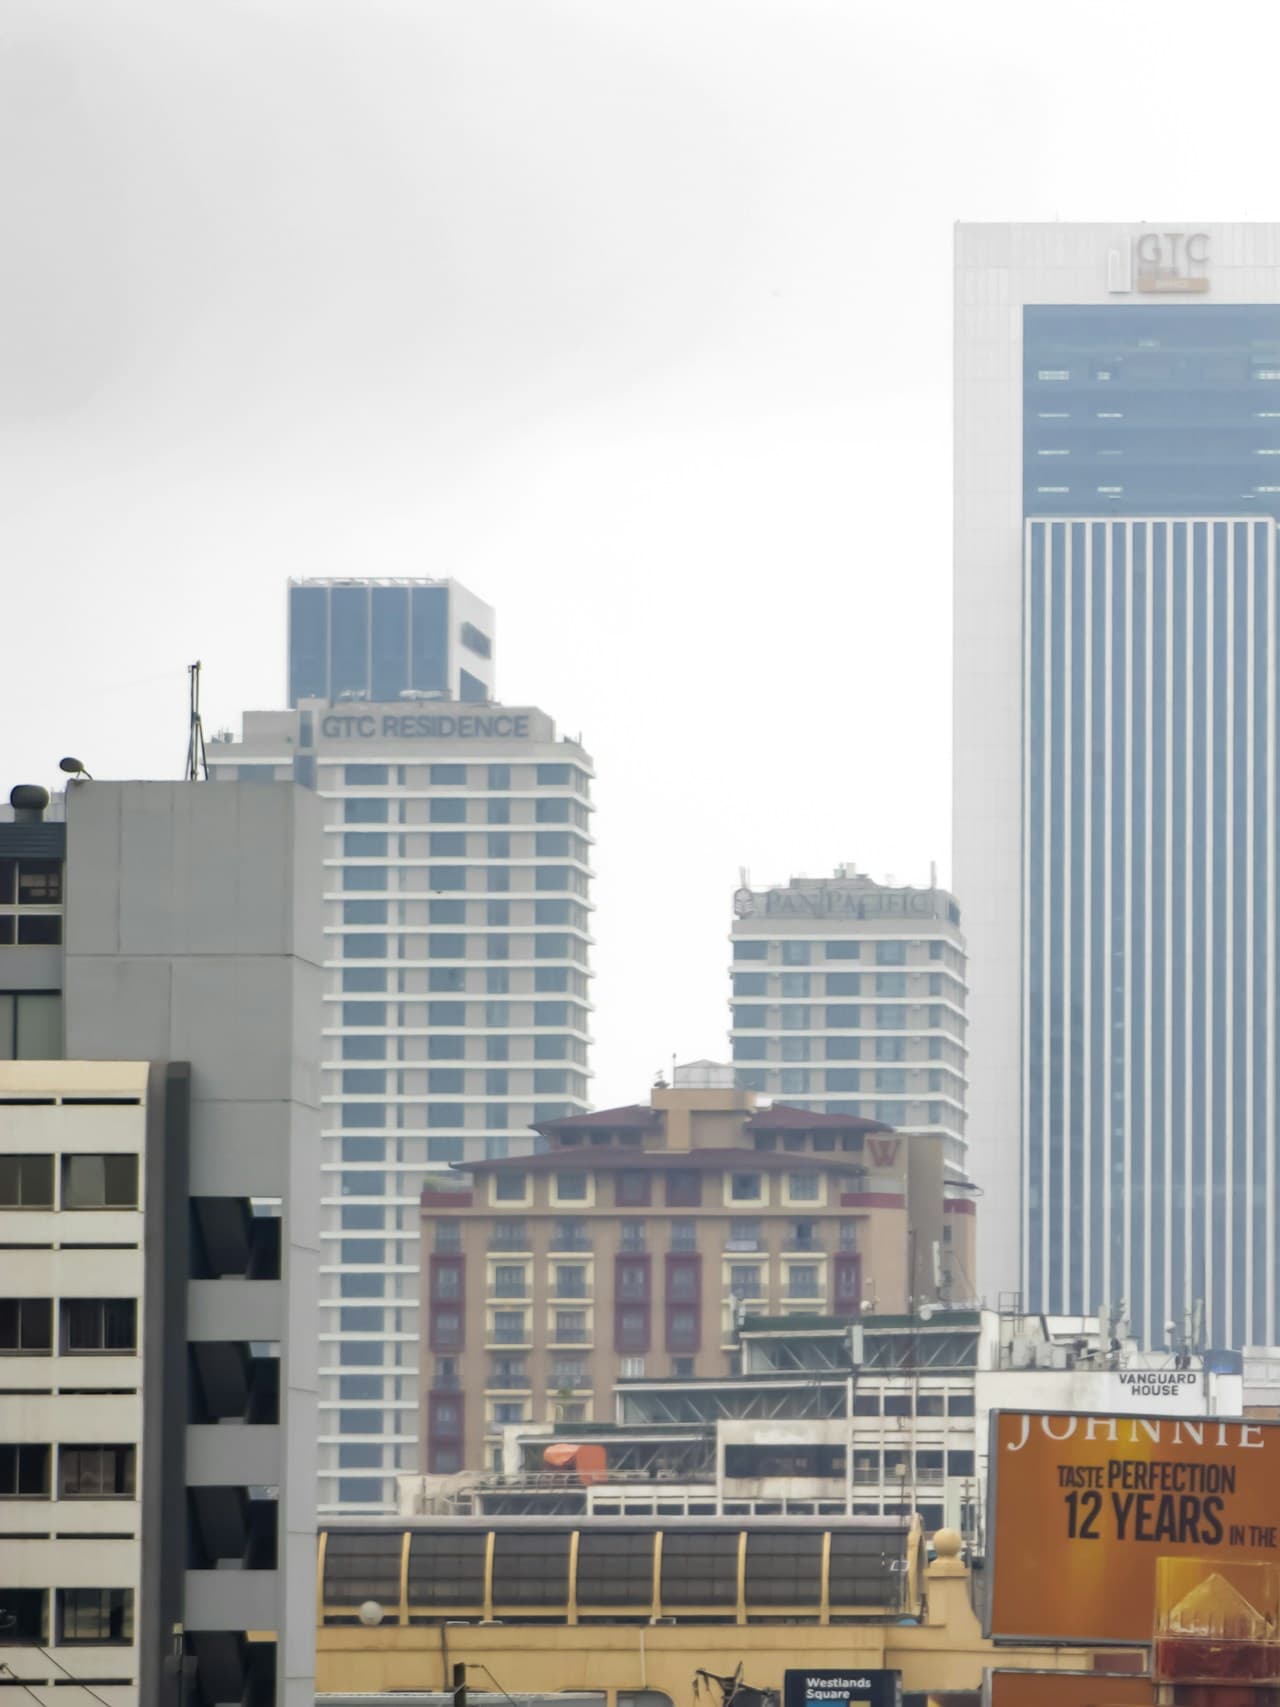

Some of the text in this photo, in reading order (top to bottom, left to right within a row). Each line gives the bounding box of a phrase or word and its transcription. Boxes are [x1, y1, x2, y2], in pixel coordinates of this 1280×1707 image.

[1137, 232, 1210, 263] GTC
[321, 714, 529, 738] GTC RESIDENCE
[1119, 1373, 1197, 1385] VANGUARD
[1131, 1385, 1179, 1396] HOUSE
[1007, 1415, 1266, 1451] JOHNNIE
[1057, 1460, 1237, 1494] TASTE PERFECTION
[1064, 1490, 1103, 1540] 12
[1111, 1491, 1225, 1546] YEARS
[1229, 1525, 1246, 1546] IN
[1248, 1526, 1277, 1548] THE
[805, 1677, 872, 1688] Westlands
[805, 1688, 851, 1700] Square
